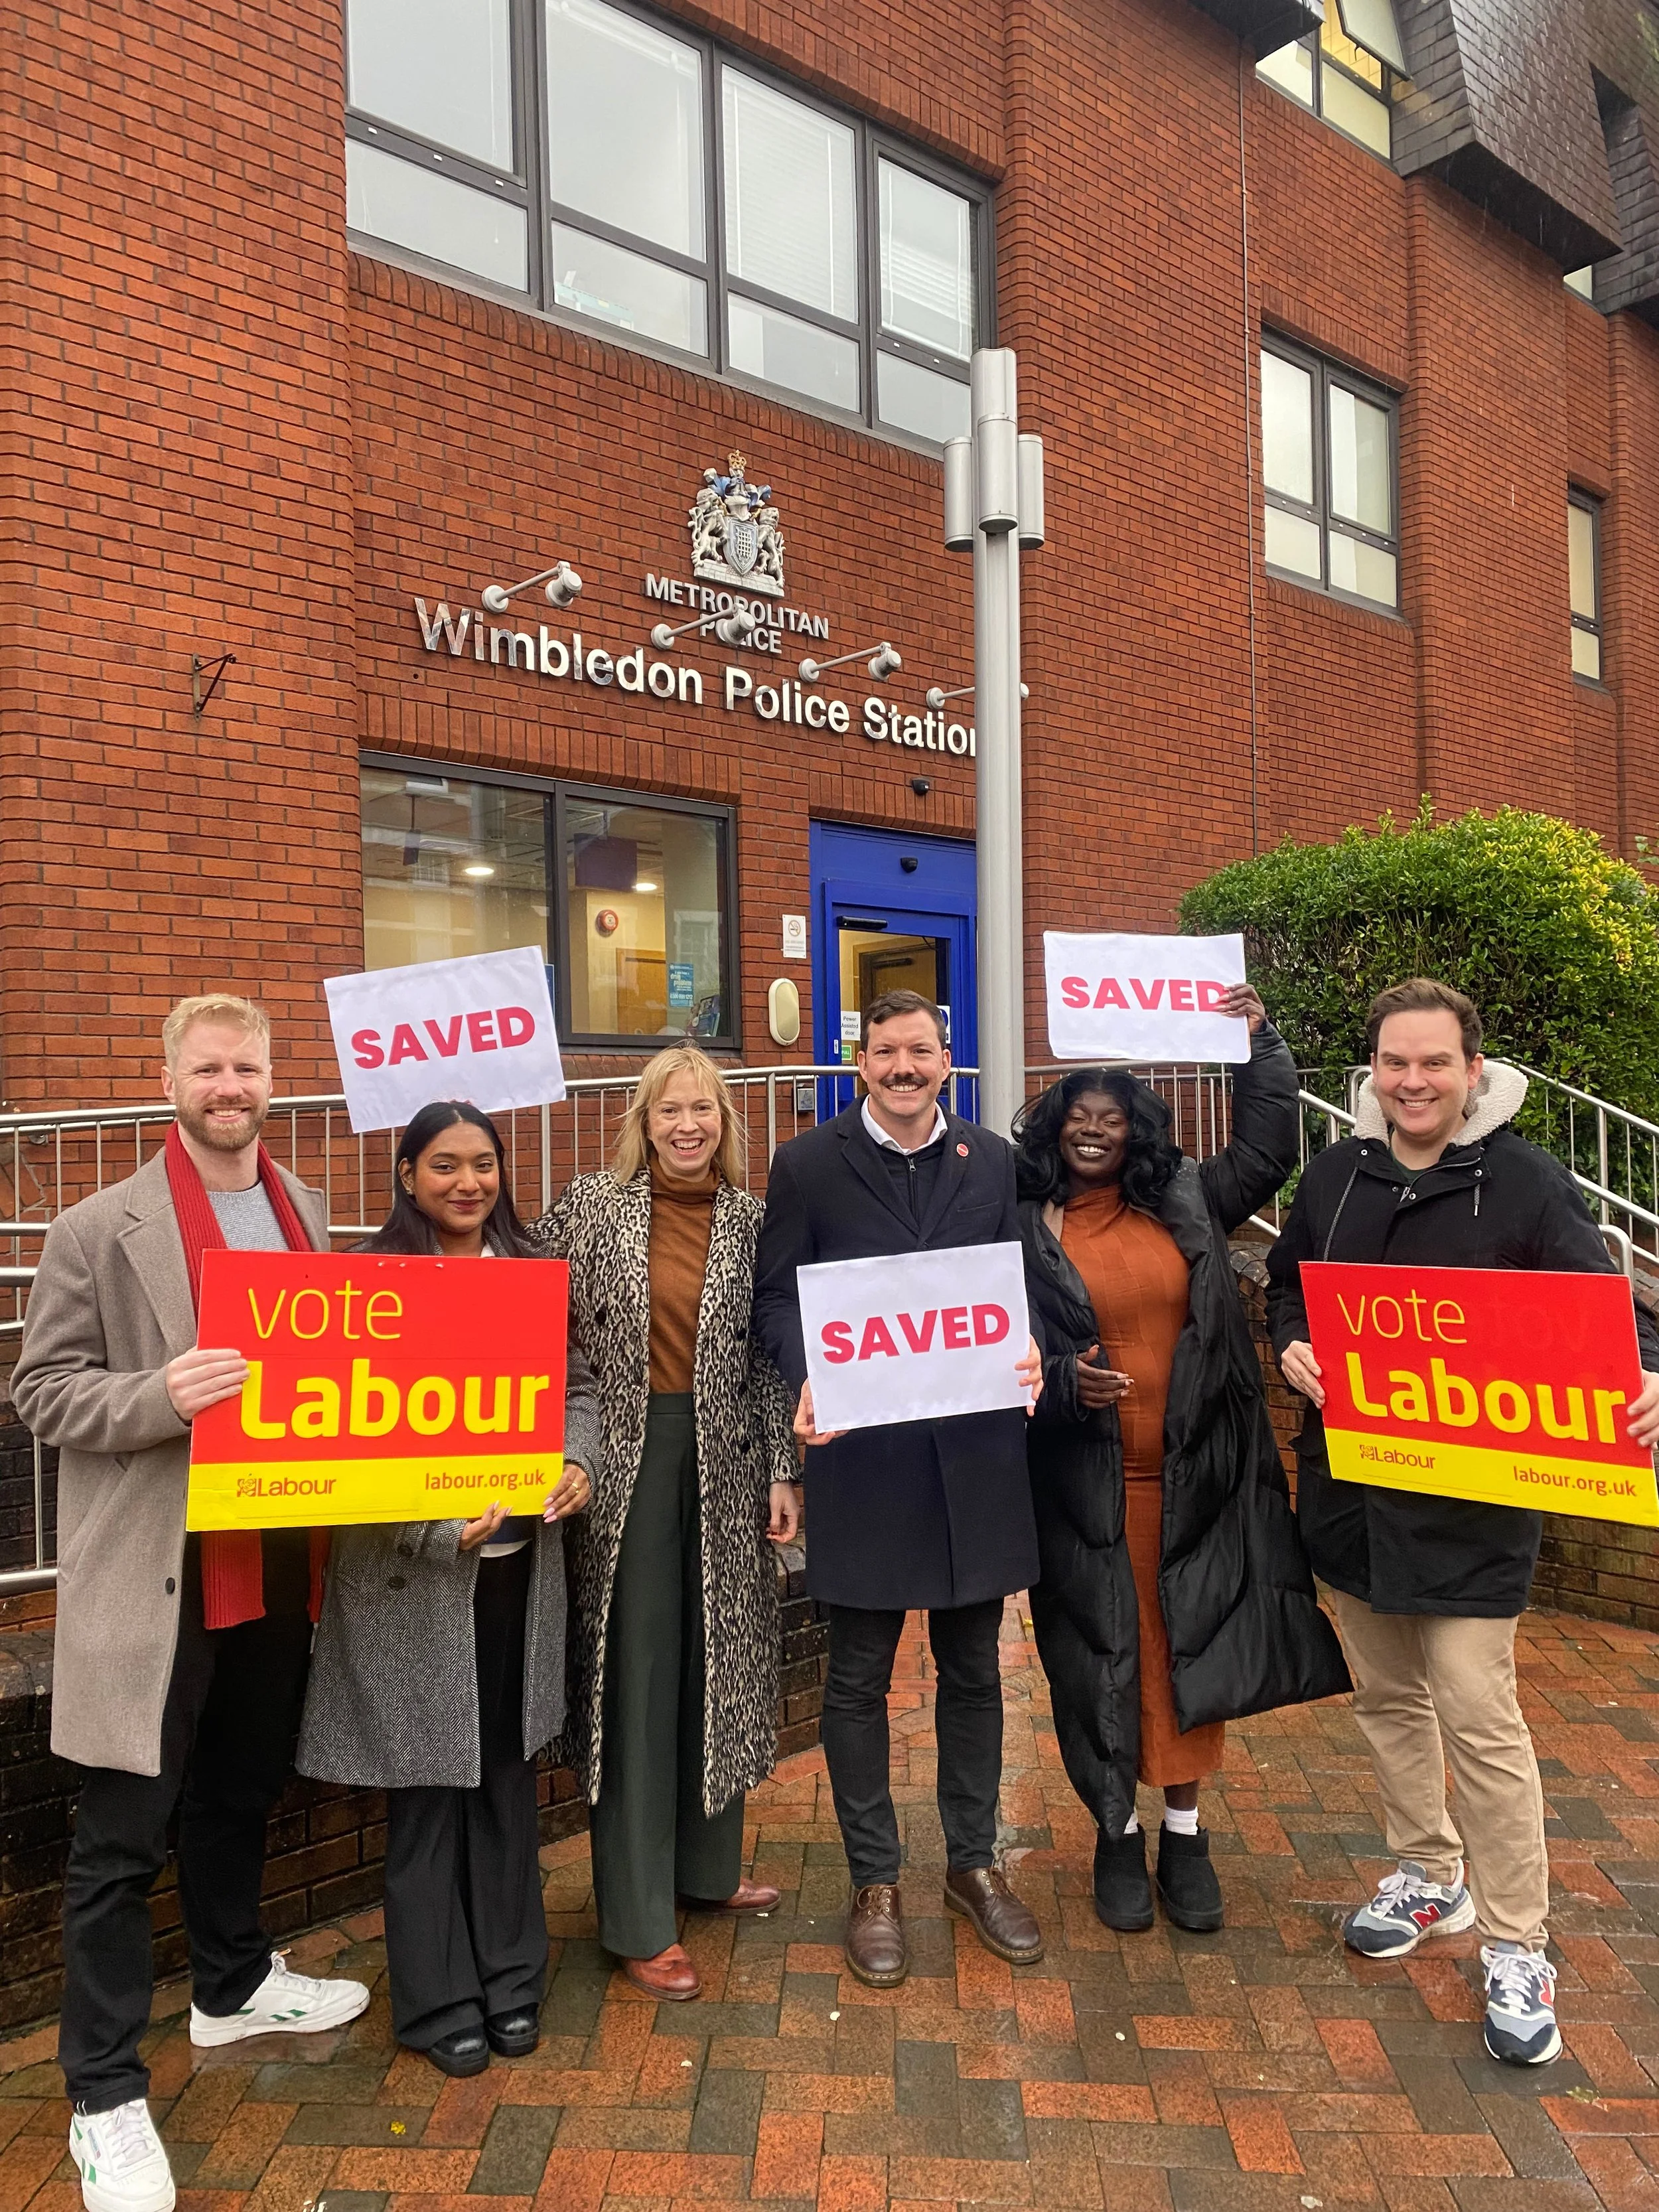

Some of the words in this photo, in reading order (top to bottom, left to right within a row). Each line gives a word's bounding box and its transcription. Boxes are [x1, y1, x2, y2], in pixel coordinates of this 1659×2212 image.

[414, 597, 703, 704] Wimbledon
[726, 666, 850, 733] Police
[350, 1006, 536, 1069] SAVED
[248, 1280, 403, 1340] vote
[820, 1303, 1010, 1364] SAVED
[1336, 1289, 1467, 1344] vote
[240, 1358, 549, 1439] Labour
[1345, 1352, 1626, 1444] Labour
[257, 1477, 336, 1497] Labour
[425, 1468, 546, 1491] labour.org.uk
[1374, 1446, 1435, 1469] Labour
[1513, 1465, 1637, 1497] labour.org.uk
